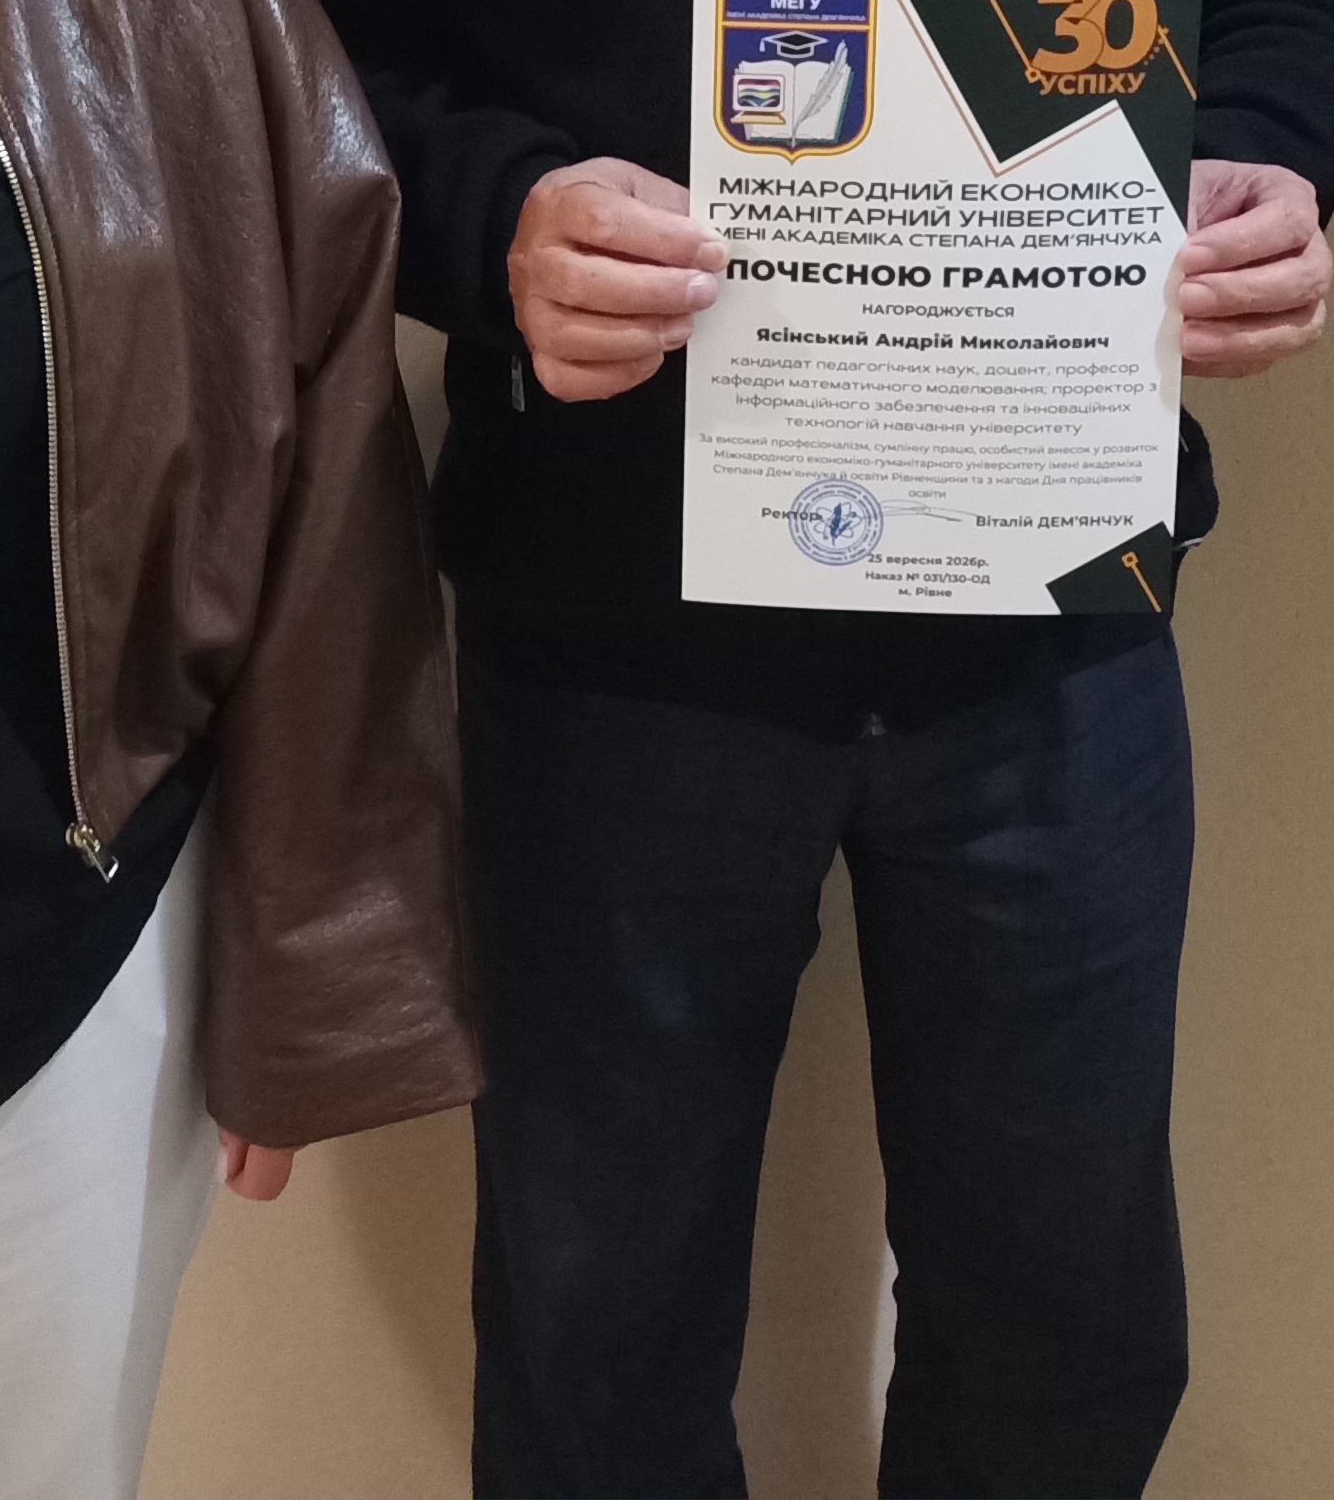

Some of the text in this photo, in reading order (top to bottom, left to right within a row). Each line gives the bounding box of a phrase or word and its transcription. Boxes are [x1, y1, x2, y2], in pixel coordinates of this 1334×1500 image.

[1039, 72, 1145, 95] УСПІХУ
[719, 177, 1156, 202] МІЖНАРОДНИЙ ЕКОНОМІКО-
[709, 202, 1165, 229] ГУМАНІТАРНИЙ УНІВЕРСИТЕТ
[771, 230, 1016, 248] АКАДЕМІКА СТЕПАНА
[726, 259, 1147, 289] ПОЧЕСНОЮ ГРАМОТОЮ
[862, 303, 1015, 319] НАГОРОДЖУЄТЬСЯ
[756, 327, 1110, 352] Ясінський Андрій Миколайович
[731, 356, 1139, 378] кандидат педагогічних професор
